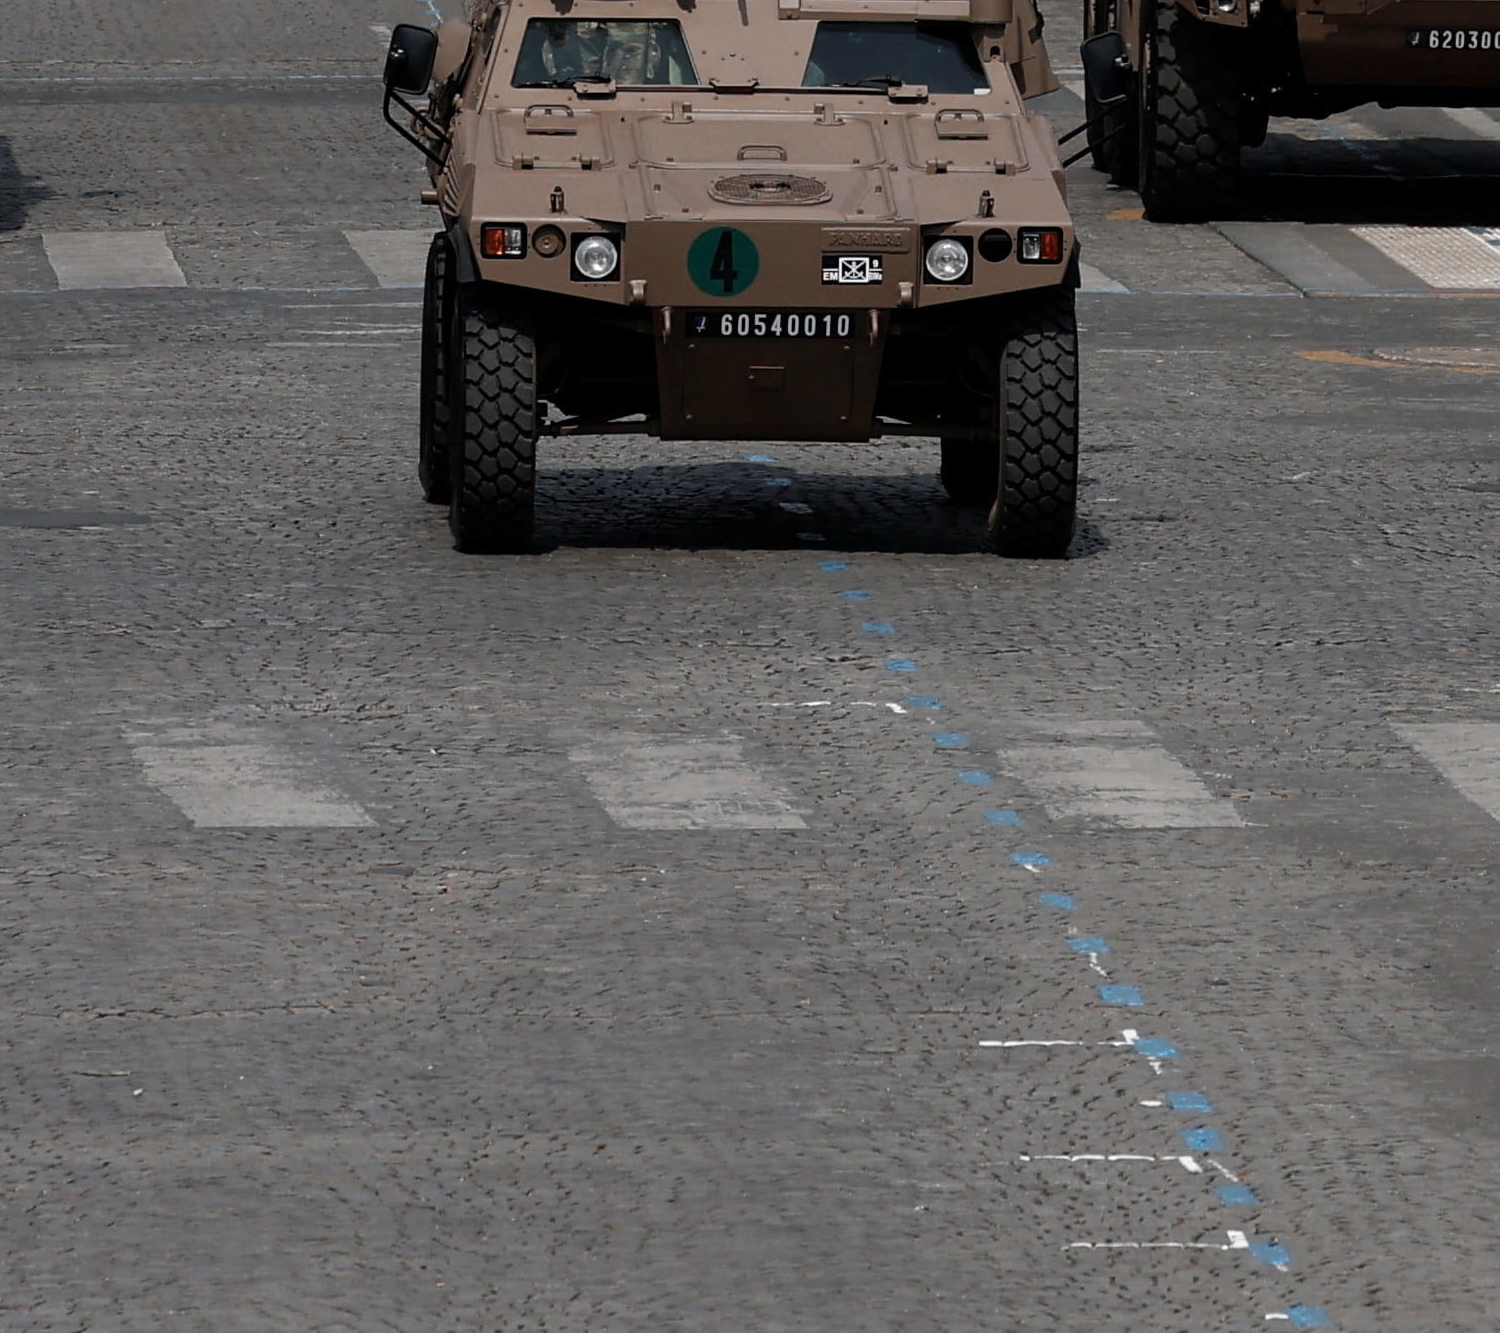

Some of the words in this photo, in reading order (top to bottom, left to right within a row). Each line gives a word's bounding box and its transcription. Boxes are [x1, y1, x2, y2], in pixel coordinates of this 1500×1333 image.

[709, 231, 738, 293] 4
[823, 272, 839, 281] EM
[720, 313, 850, 337] 60540010
